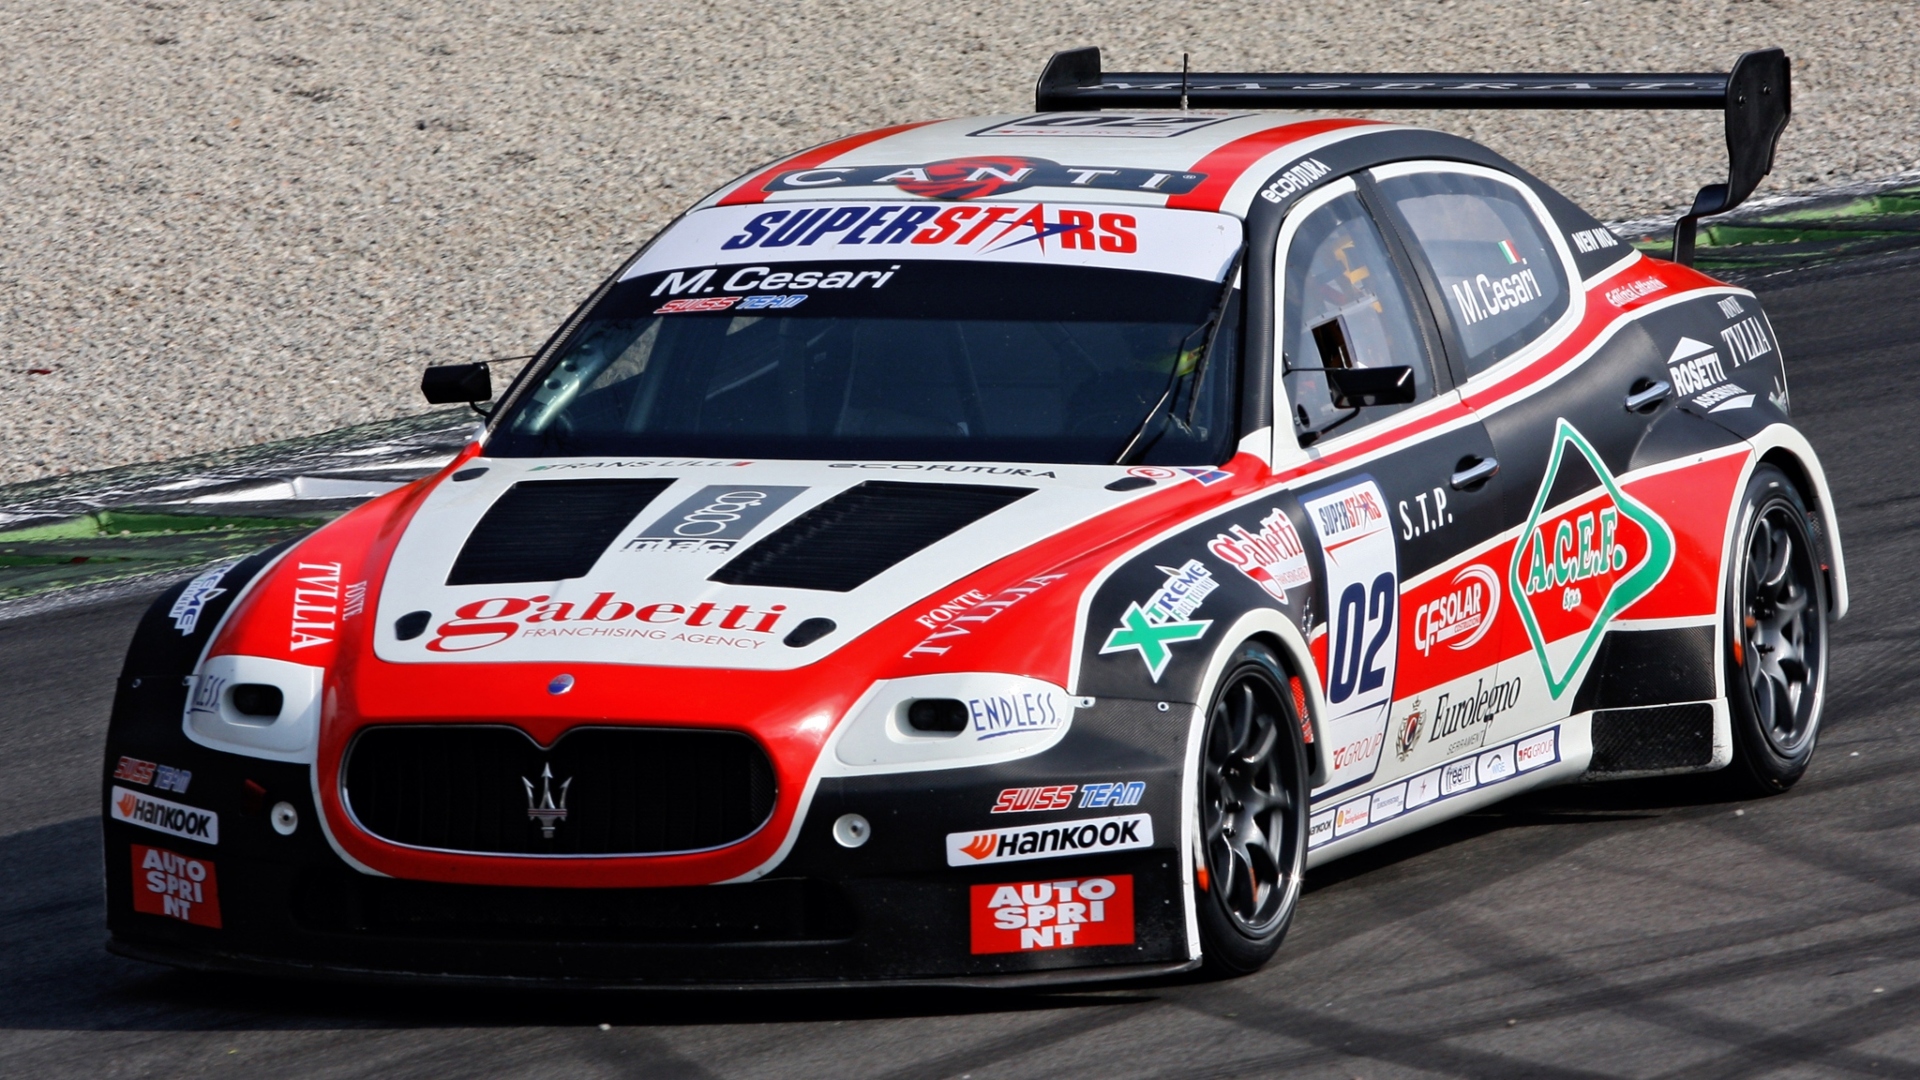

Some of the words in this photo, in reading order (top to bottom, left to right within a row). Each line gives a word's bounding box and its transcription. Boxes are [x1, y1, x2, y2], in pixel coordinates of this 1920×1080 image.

[783, 167, 1178, 189] CANTI
[721, 203, 1138, 256] SUPERSTARS
[722, 264, 902, 292] Cesari
[653, 296, 743, 315] SWISS
[735, 294, 809, 310] TEAM
[1669, 352, 1728, 397] ROSETTI
[1318, 490, 1382, 537] SUPERSTARS
[1398, 487, 1453, 541] S.T.P.
[1526, 506, 1628, 596] A.C.E.F.
[289, 561, 342, 652] TVLLIA
[425, 591, 788, 653] gabetti
[903, 572, 1069, 659] TVLLIA
[915, 588, 993, 630] FONTE
[1439, 582, 1482, 629] SOLAR
[521, 626, 667, 641] FRANCHISING
[670, 631, 766, 651] AGENCY
[1329, 571, 1395, 705] 02
[968, 692, 1057, 732] ENDLESS
[1428, 676, 1522, 744] Eurolegno
[113, 756, 157, 786] SWISS
[154, 764, 192, 794] TEAM
[990, 785, 1079, 813] SWISS
[1078, 781, 1146, 809] TEAM
[142, 849, 207, 883] AUTO
[146, 871, 203, 903] SPRI
[987, 878, 1117, 909] AUTO
[163, 895, 191, 921] NT
[993, 900, 1105, 930] SPRI
[1020, 924, 1081, 950] NT
